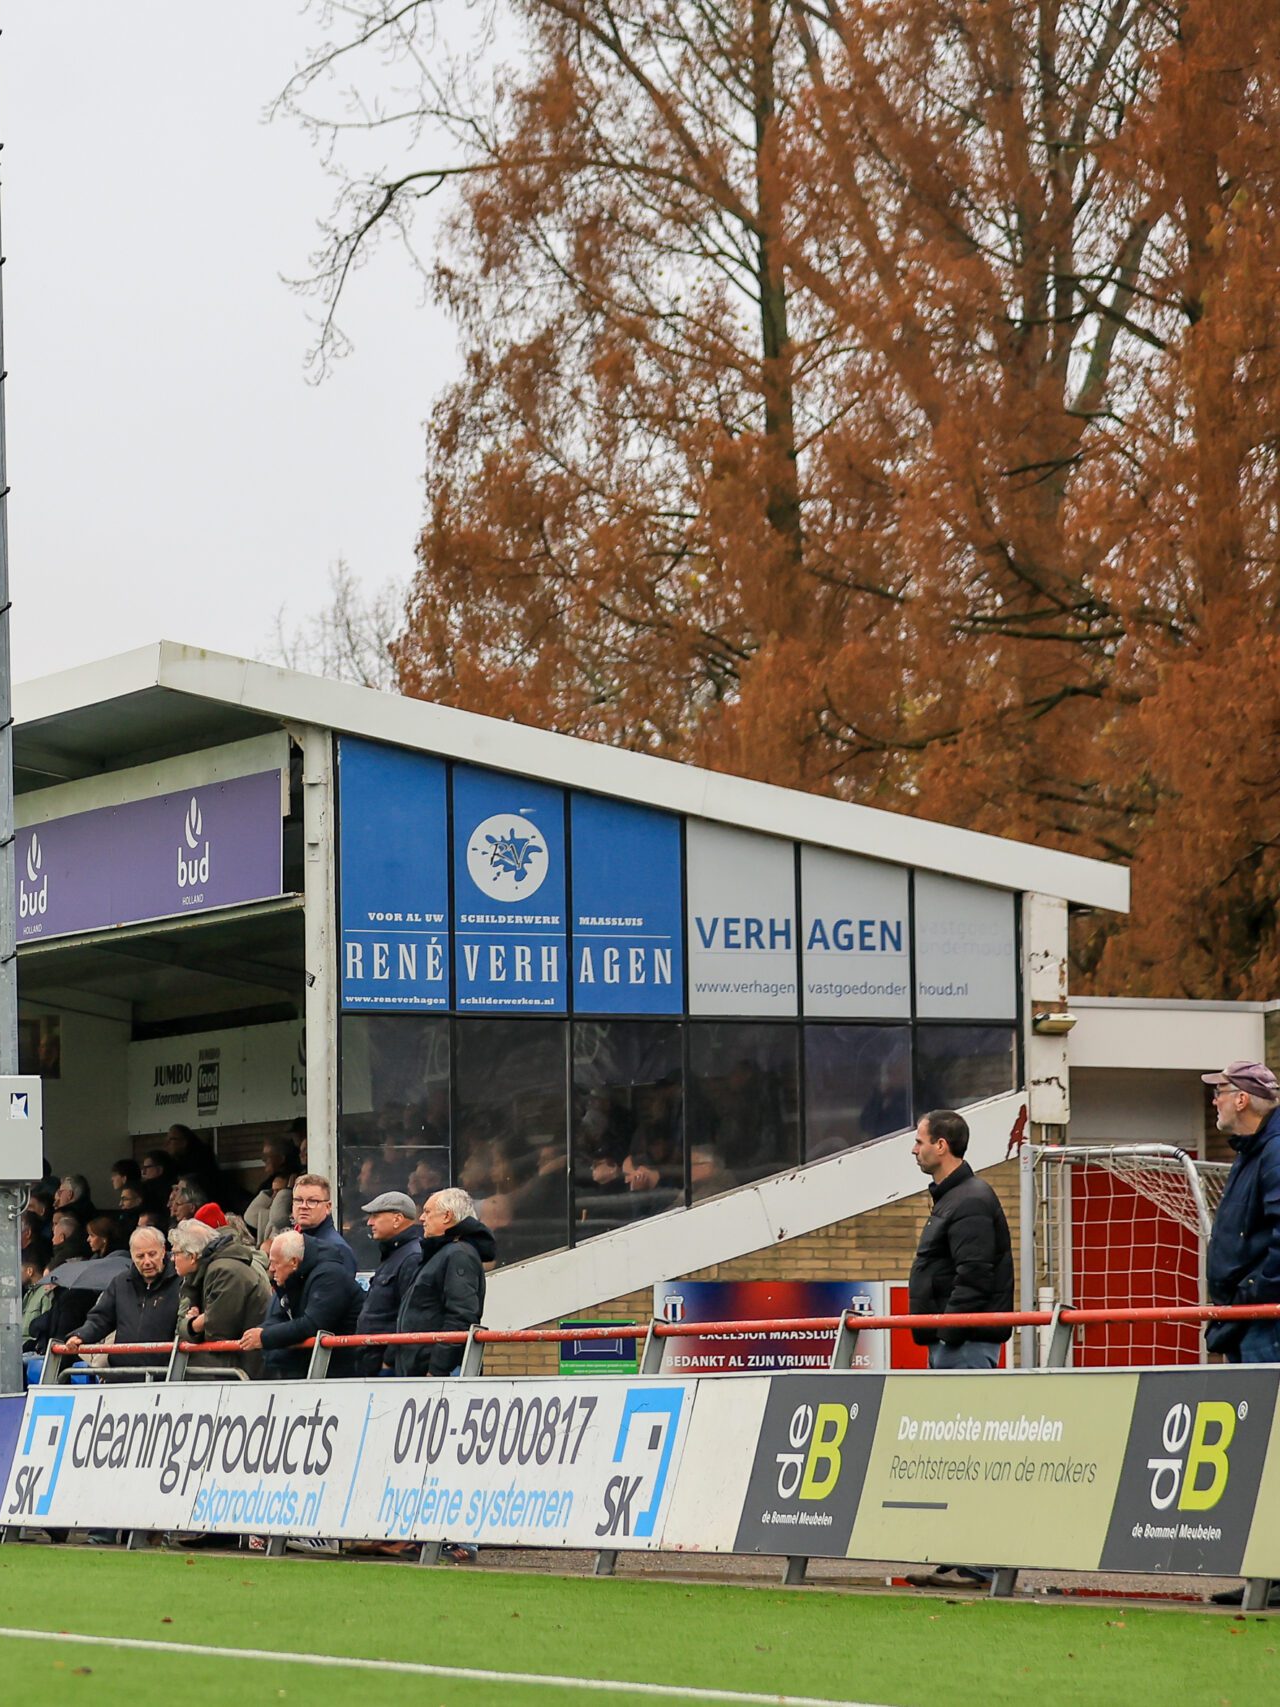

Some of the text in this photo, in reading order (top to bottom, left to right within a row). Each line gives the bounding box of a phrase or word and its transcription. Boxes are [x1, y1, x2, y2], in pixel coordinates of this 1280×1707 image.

[177, 841, 209, 888] bud
[19, 874, 48, 918] bud
[182, 893, 204, 906] HOLLAND
[23, 923, 43, 935] HOLLAND
[368, 912, 643, 927] VOOR AL UW SCHILDERWERK MAASSLUIS
[345, 937, 443, 981] RENÉ
[154, 1063, 192, 1087] JUMBO
[667, 1355, 726, 1367] BEDANKT
[728, 1355, 744, 1367] AL
[748, 1355, 775, 1367] ZIJN
[393, 1395, 598, 1466] 010-5900817
[897, 1413, 1064, 1442] De mooiste meubelen
[890, 1454, 1097, 1483] Rechtstreeks van de makers
[8, 1465, 44, 1515] SK
[193, 1479, 326, 1529] skproducts.nl
[377, 1476, 575, 1538] hygiëne systemen
[595, 1475, 642, 1537] SK
[762, 1511, 833, 1526] de Bommel Meubelen
[1132, 1522, 1222, 1541] de Bommel Meubelen
